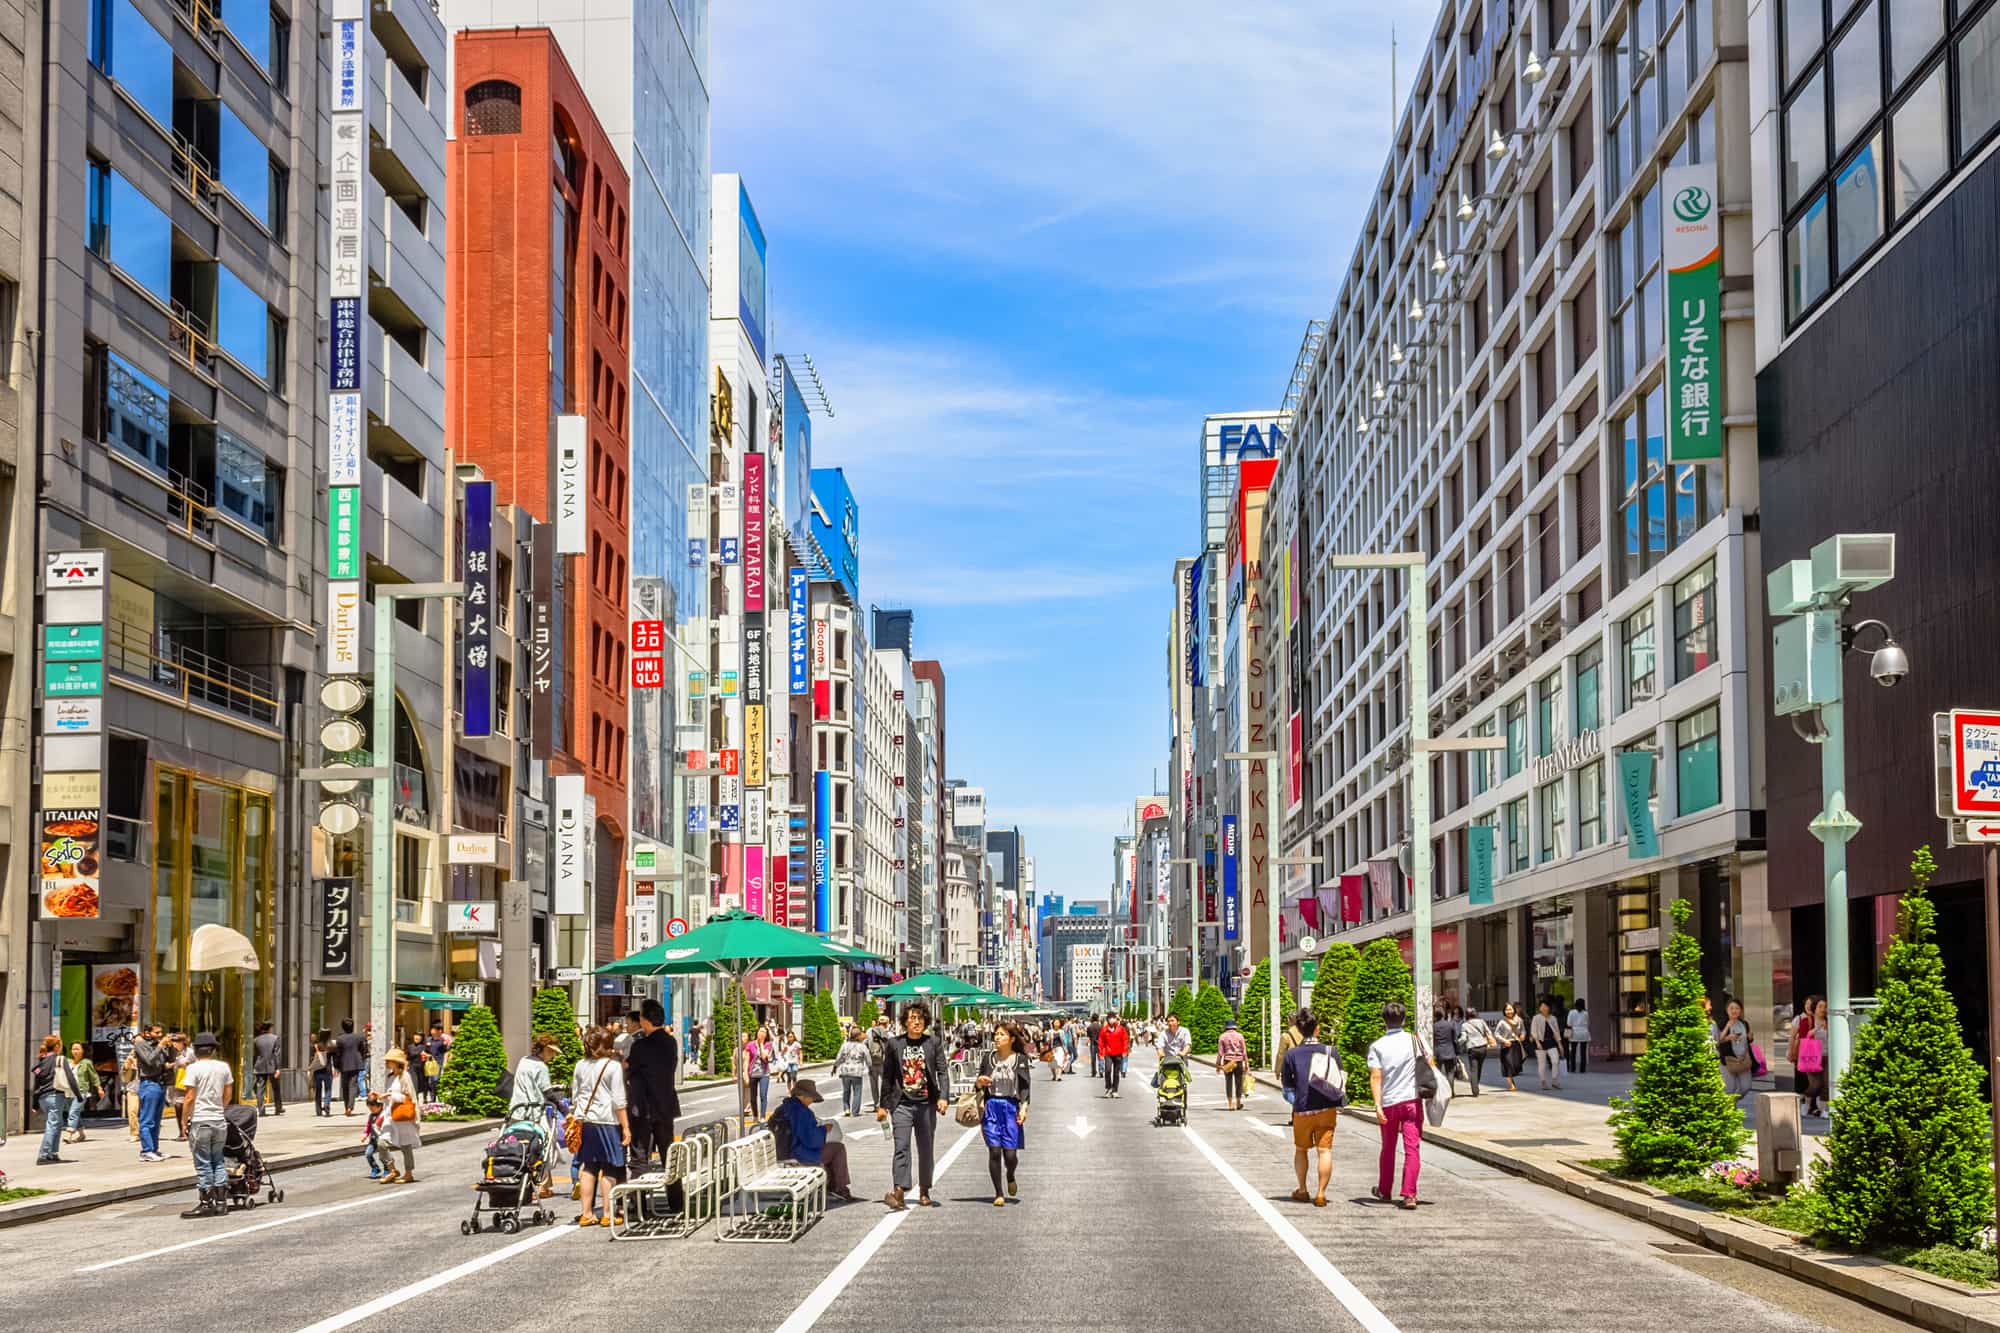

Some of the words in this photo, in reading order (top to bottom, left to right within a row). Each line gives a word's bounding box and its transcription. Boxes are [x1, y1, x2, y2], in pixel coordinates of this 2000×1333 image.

[335, 151, 359, 287] 企画通信社
[336, 299, 356, 389] 銀座総合法律事務所
[1679, 298, 1710, 438] りそな銀行
[562, 460, 576, 519] DIANA
[746, 520, 761, 598] NATARAJ
[336, 592, 358, 663] Darling
[467, 550, 489, 670] 銀座大増
[746, 630, 761, 639] 6F
[534, 627, 550, 693] ヨシノヤ
[636, 662, 659, 671] UNI
[816, 619, 827, 664] docomo
[636, 672, 660, 684] QLO
[792, 681, 805, 690] 6F
[1248, 559, 1267, 908] MATSUZAKAYA
[1966, 727, 1999, 738] タクシー
[45, 810, 99, 822] ITALIAN
[1227, 823, 1235, 856] MIZUHO
[559, 820, 577, 880] DIANA
[815, 838, 825, 886] citibank
[325, 886, 351, 969] タカゲン
[670, 923, 684, 935] 50
[1074, 947, 1101, 957] LIXIL
